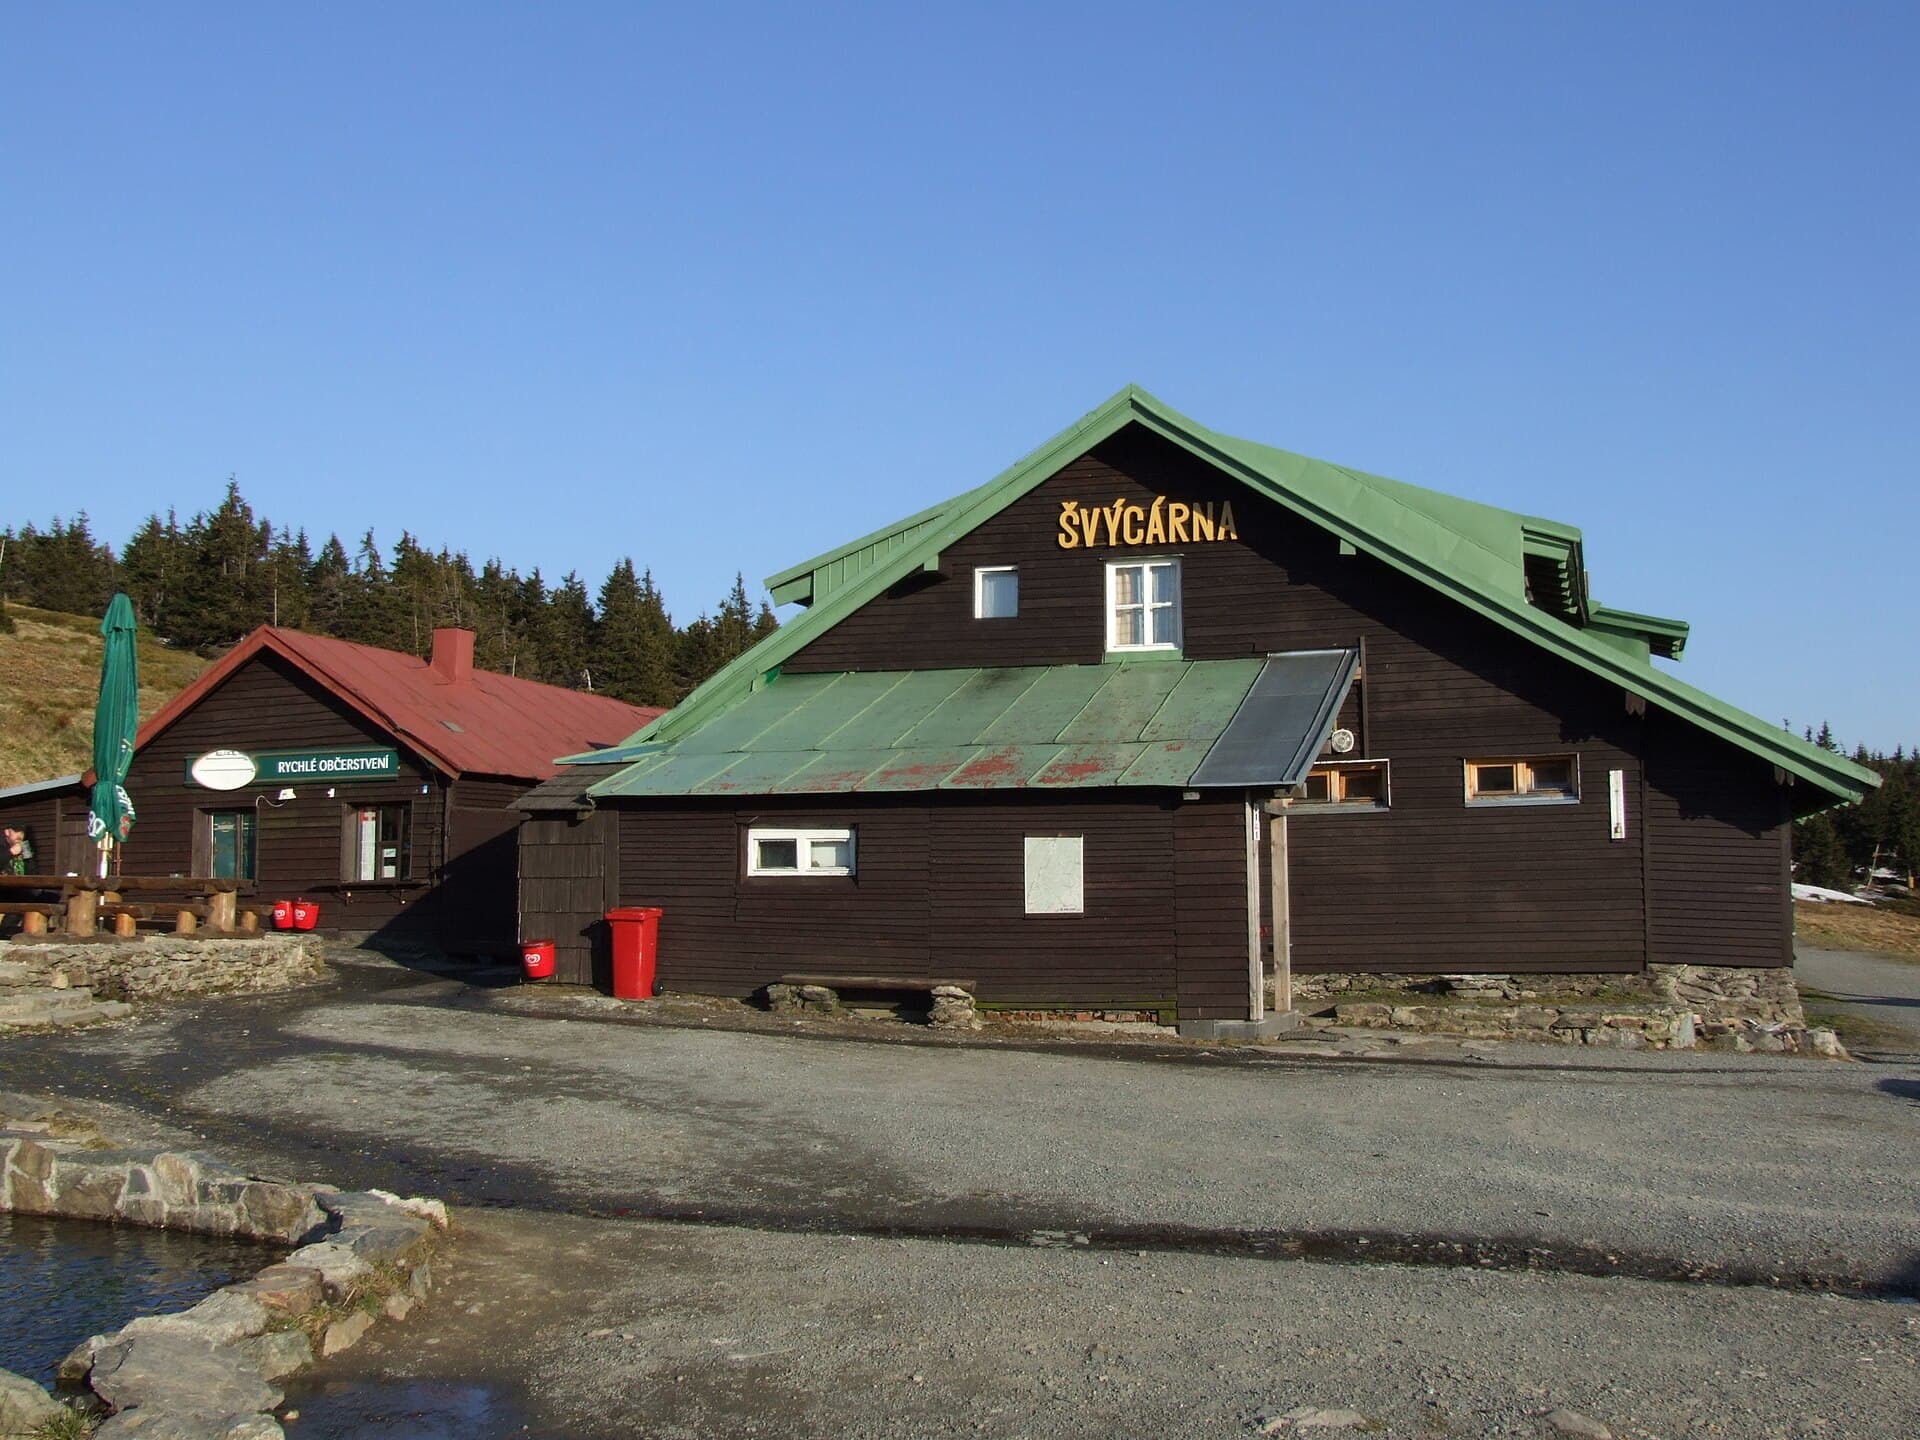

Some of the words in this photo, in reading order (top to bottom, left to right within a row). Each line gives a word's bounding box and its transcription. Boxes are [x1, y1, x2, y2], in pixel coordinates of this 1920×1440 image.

[1058, 496, 1238, 548] ŠVÝCÁRNA
[278, 758, 316, 773] RYCHLÉ
[319, 755, 389, 772] OBČERSTVENÍ
